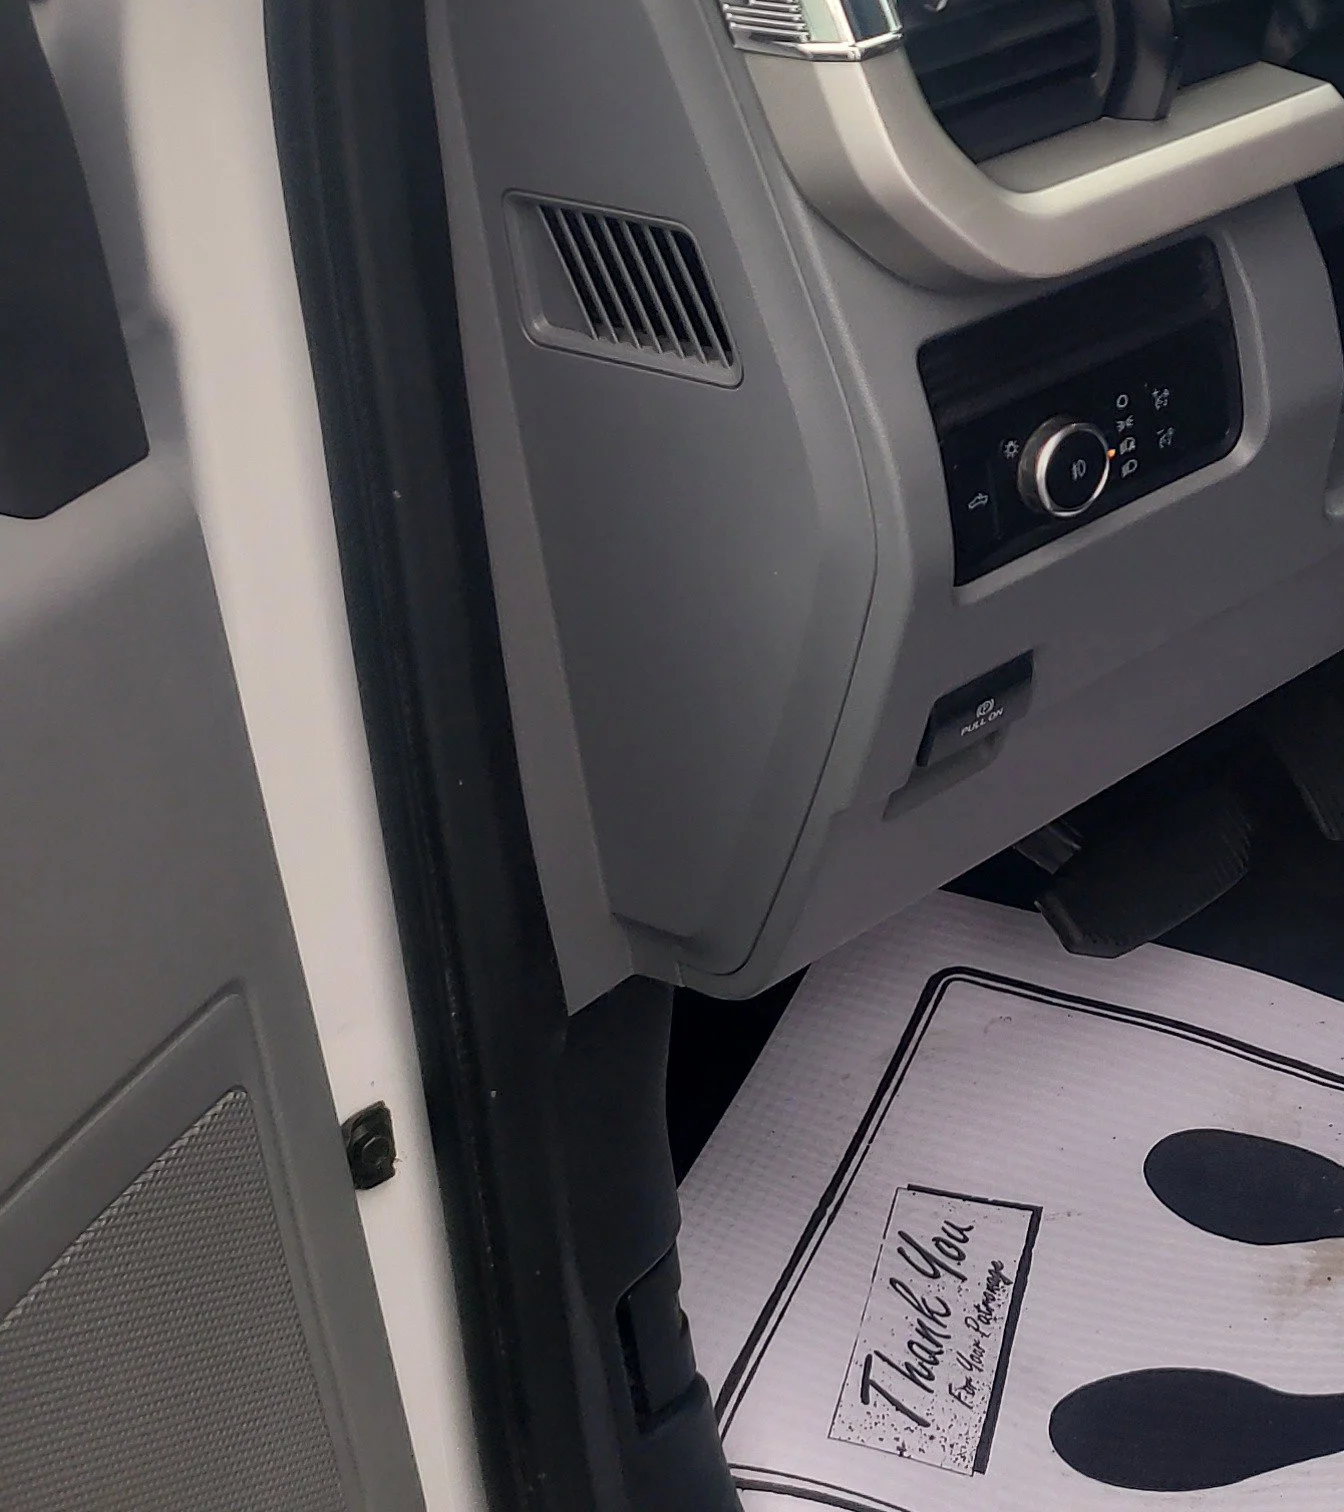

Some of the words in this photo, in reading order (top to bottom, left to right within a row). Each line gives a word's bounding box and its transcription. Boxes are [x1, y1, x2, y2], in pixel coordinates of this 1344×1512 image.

[961, 718, 986, 737] PULL
[988, 707, 1004, 722] ON
[897, 1219, 975, 1283] You
[964, 1259, 1014, 1339] Patronage
[860, 1276, 952, 1428] Thank
[956, 1338, 987, 1373] Your
[949, 1376, 980, 1410] For
